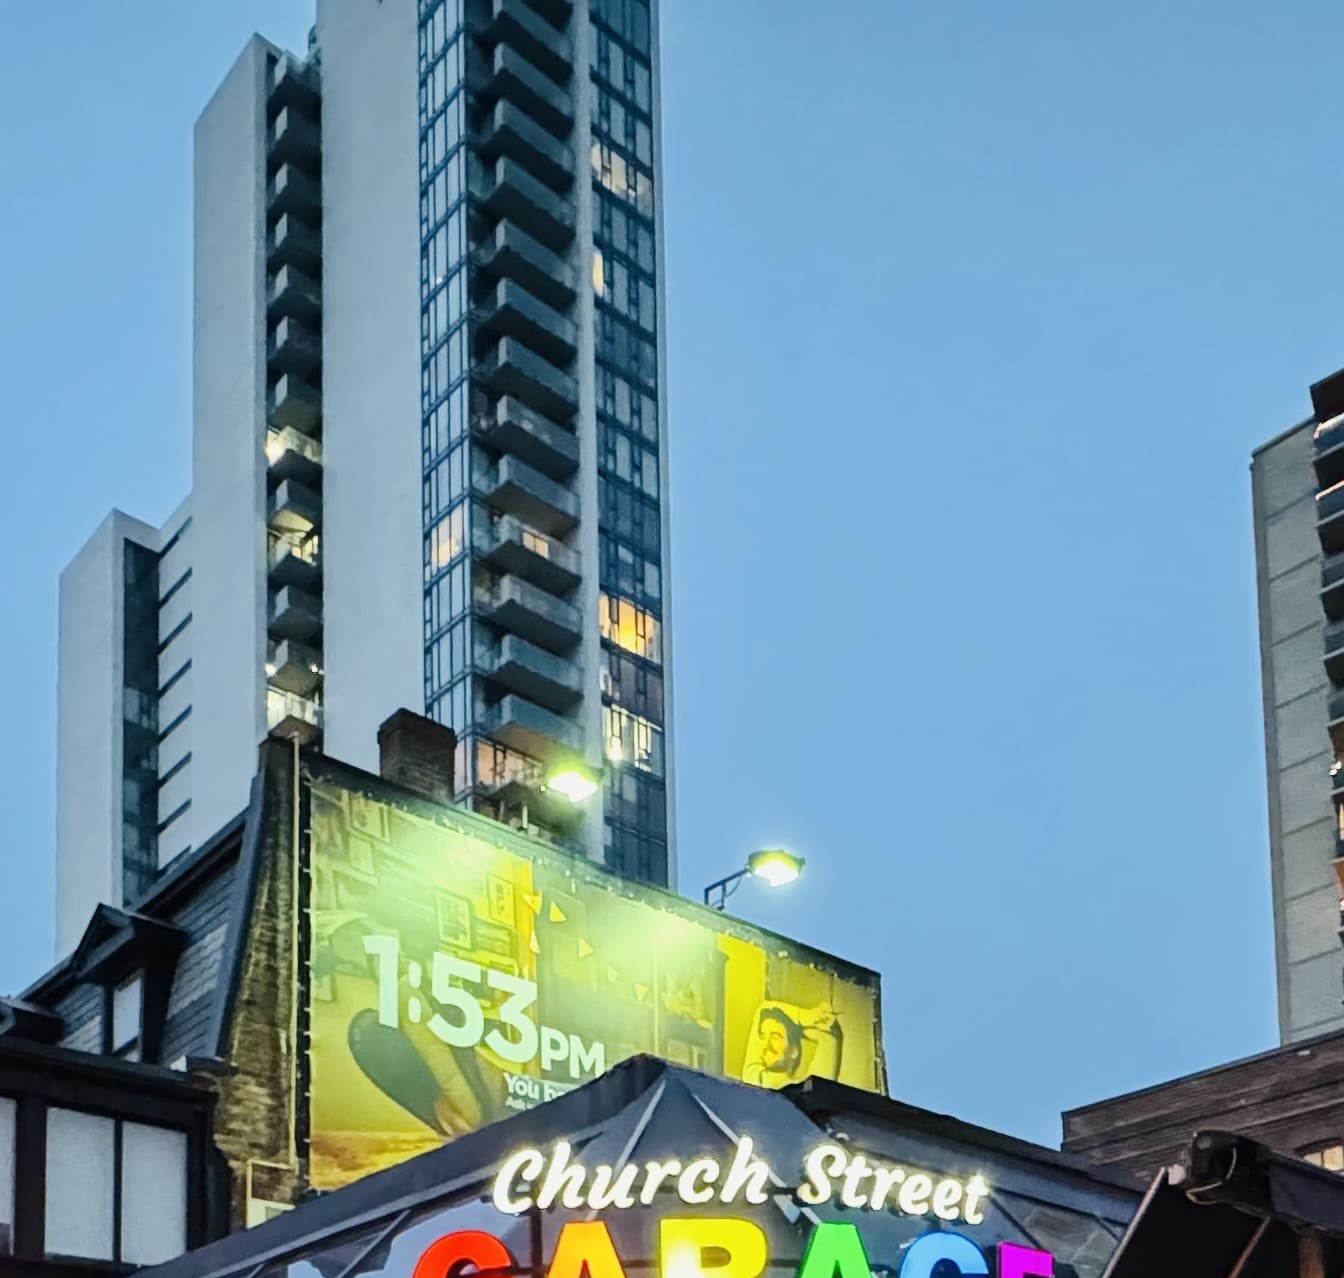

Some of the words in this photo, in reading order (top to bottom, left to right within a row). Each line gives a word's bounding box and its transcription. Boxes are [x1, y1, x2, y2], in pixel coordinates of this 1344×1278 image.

[503, 1071, 540, 1101] You
[493, 1135, 772, 1216] Church
[799, 1143, 991, 1226] Street
